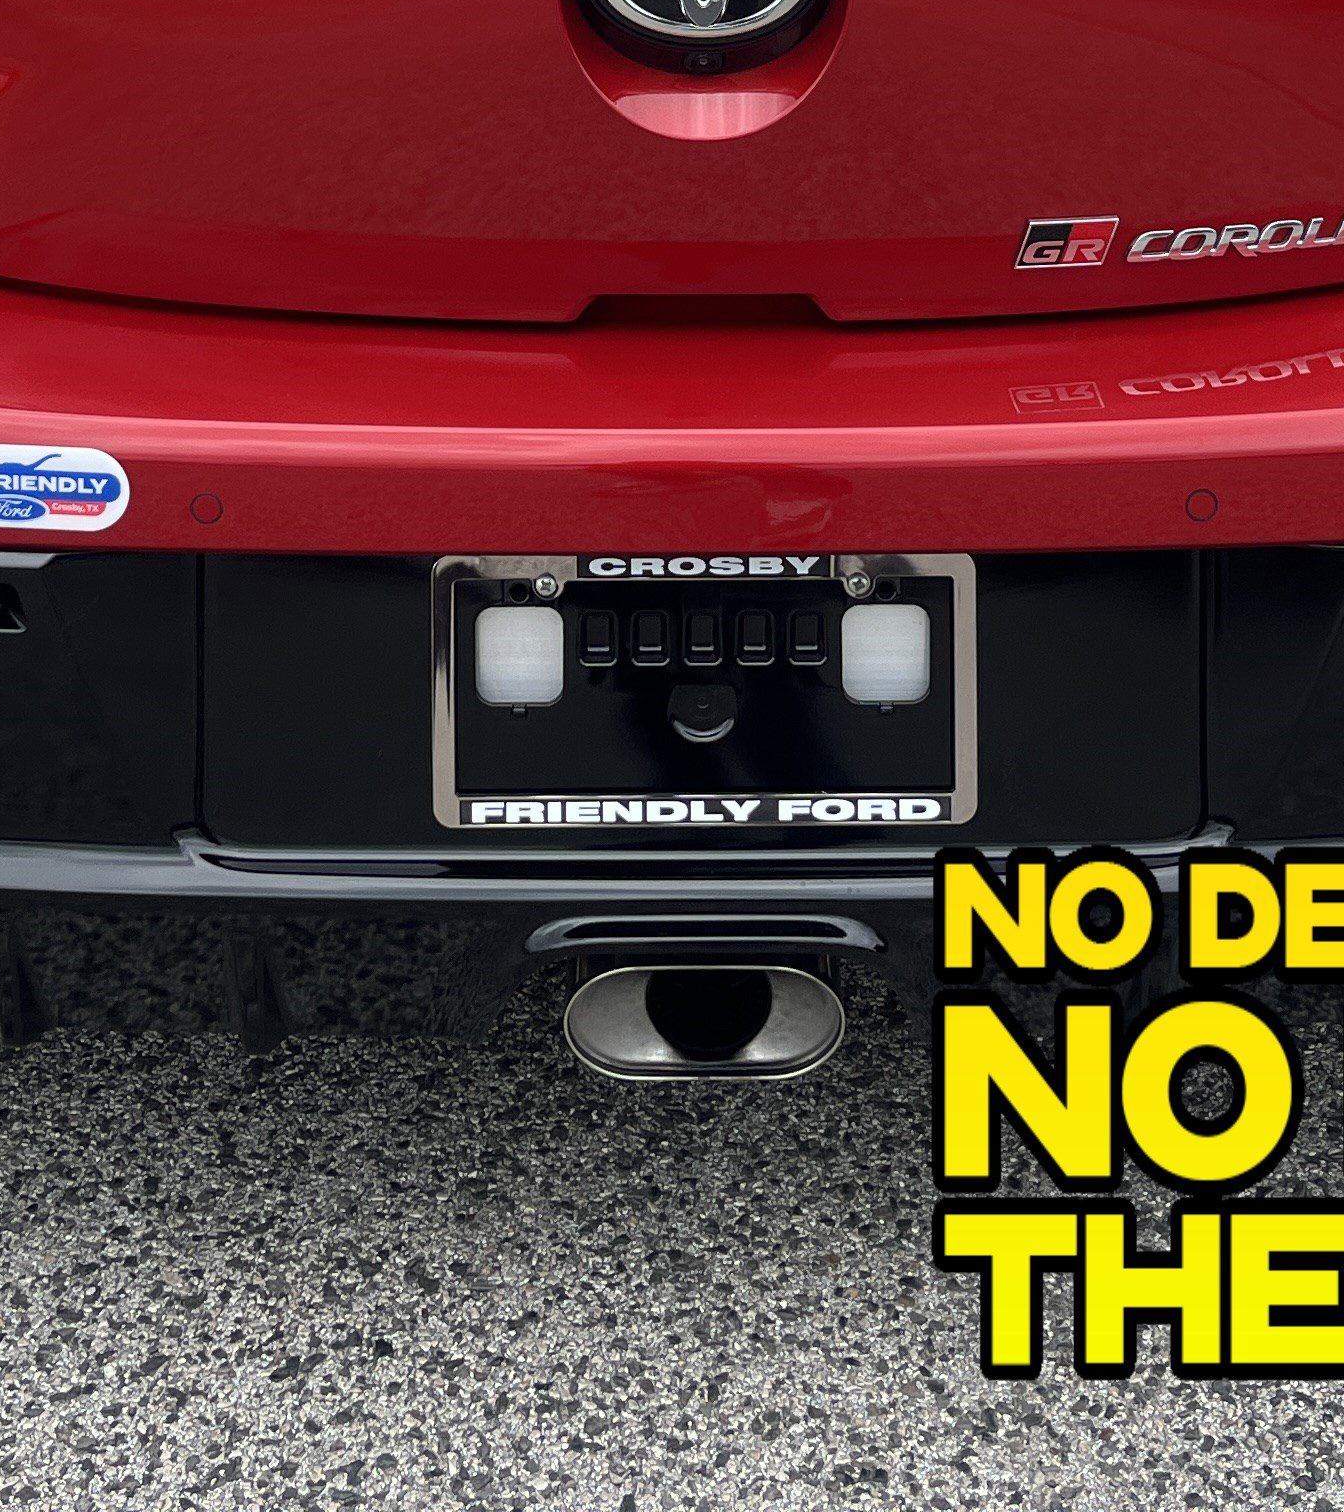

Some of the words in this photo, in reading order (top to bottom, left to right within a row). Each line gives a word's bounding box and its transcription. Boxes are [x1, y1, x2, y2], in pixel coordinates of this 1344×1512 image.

[1022, 239, 1106, 264] GR
[87, 503, 100, 513] TX
[588, 555, 821, 576] CROSBY
[470, 800, 761, 824] FRIENDLY
[777, 798, 942, 822] FORD
